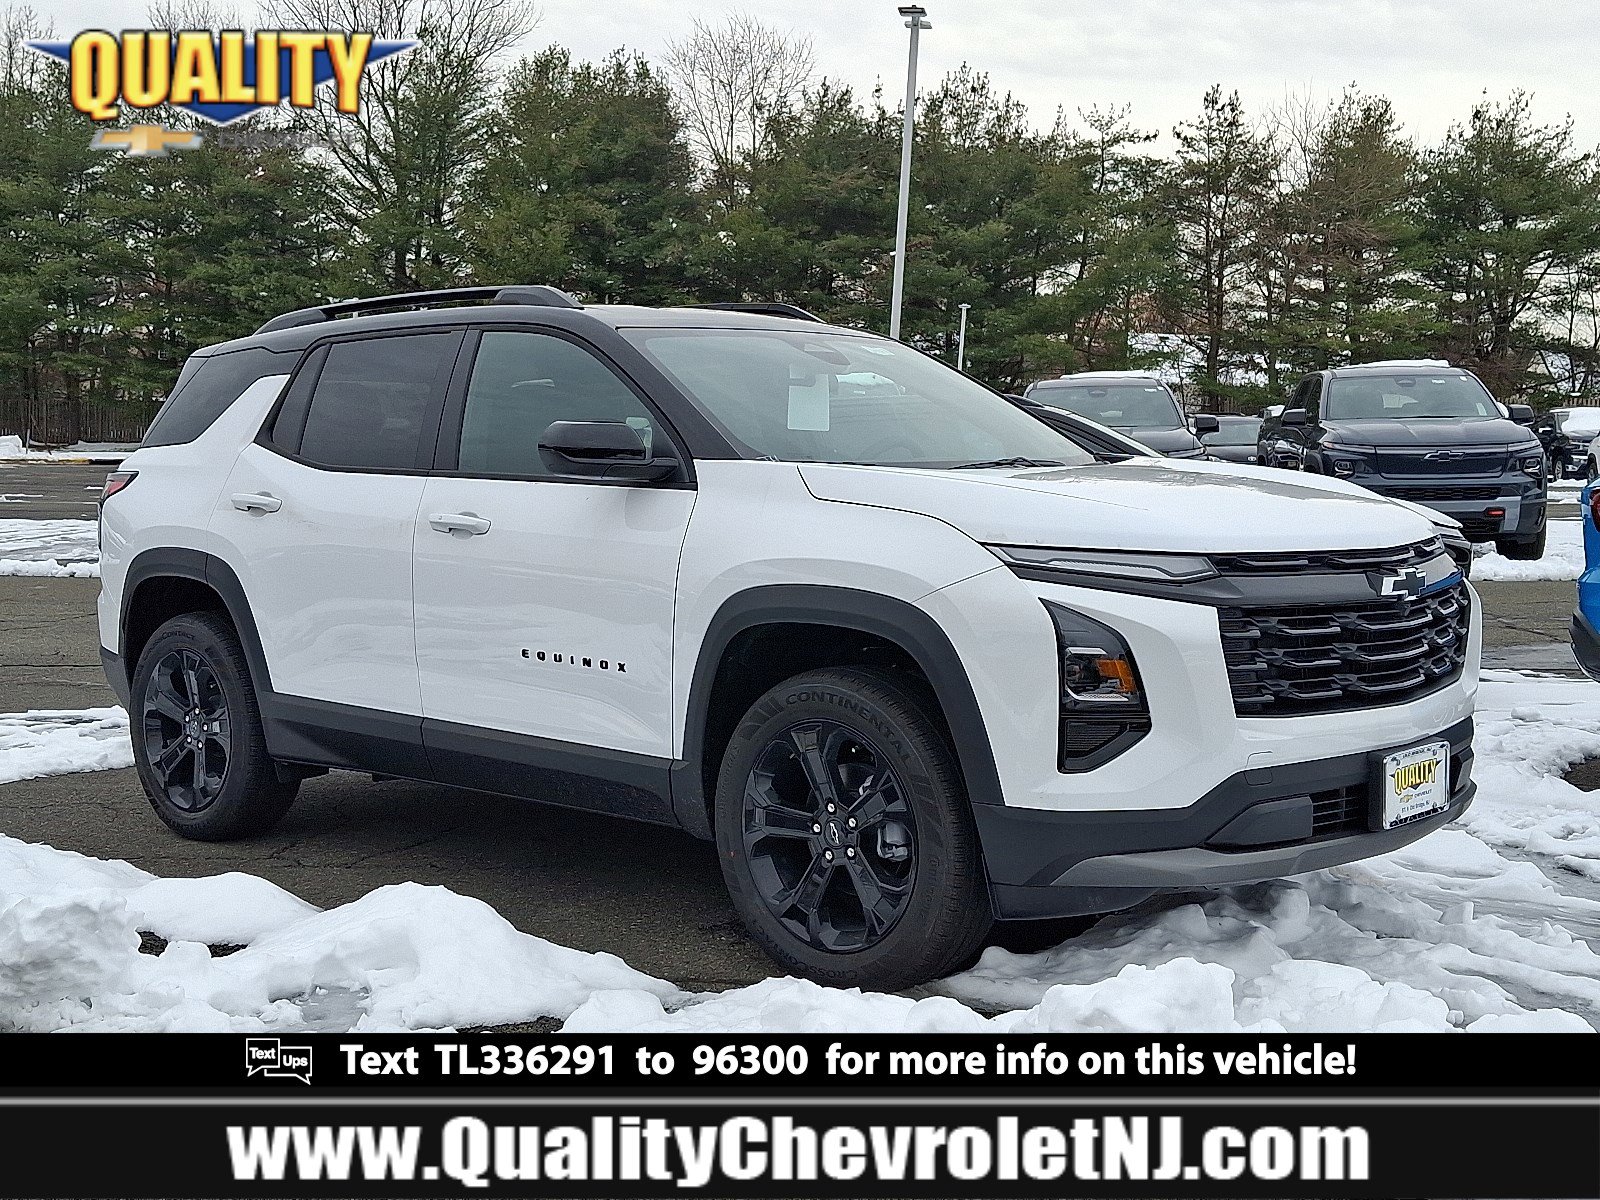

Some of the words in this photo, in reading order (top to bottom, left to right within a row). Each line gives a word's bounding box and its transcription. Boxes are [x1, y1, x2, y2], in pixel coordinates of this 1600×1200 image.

[521, 648, 627, 673] EQUINOX
[785, 690, 912, 766] CONTINENTAL
[1394, 758, 1437, 795] QUALITY
